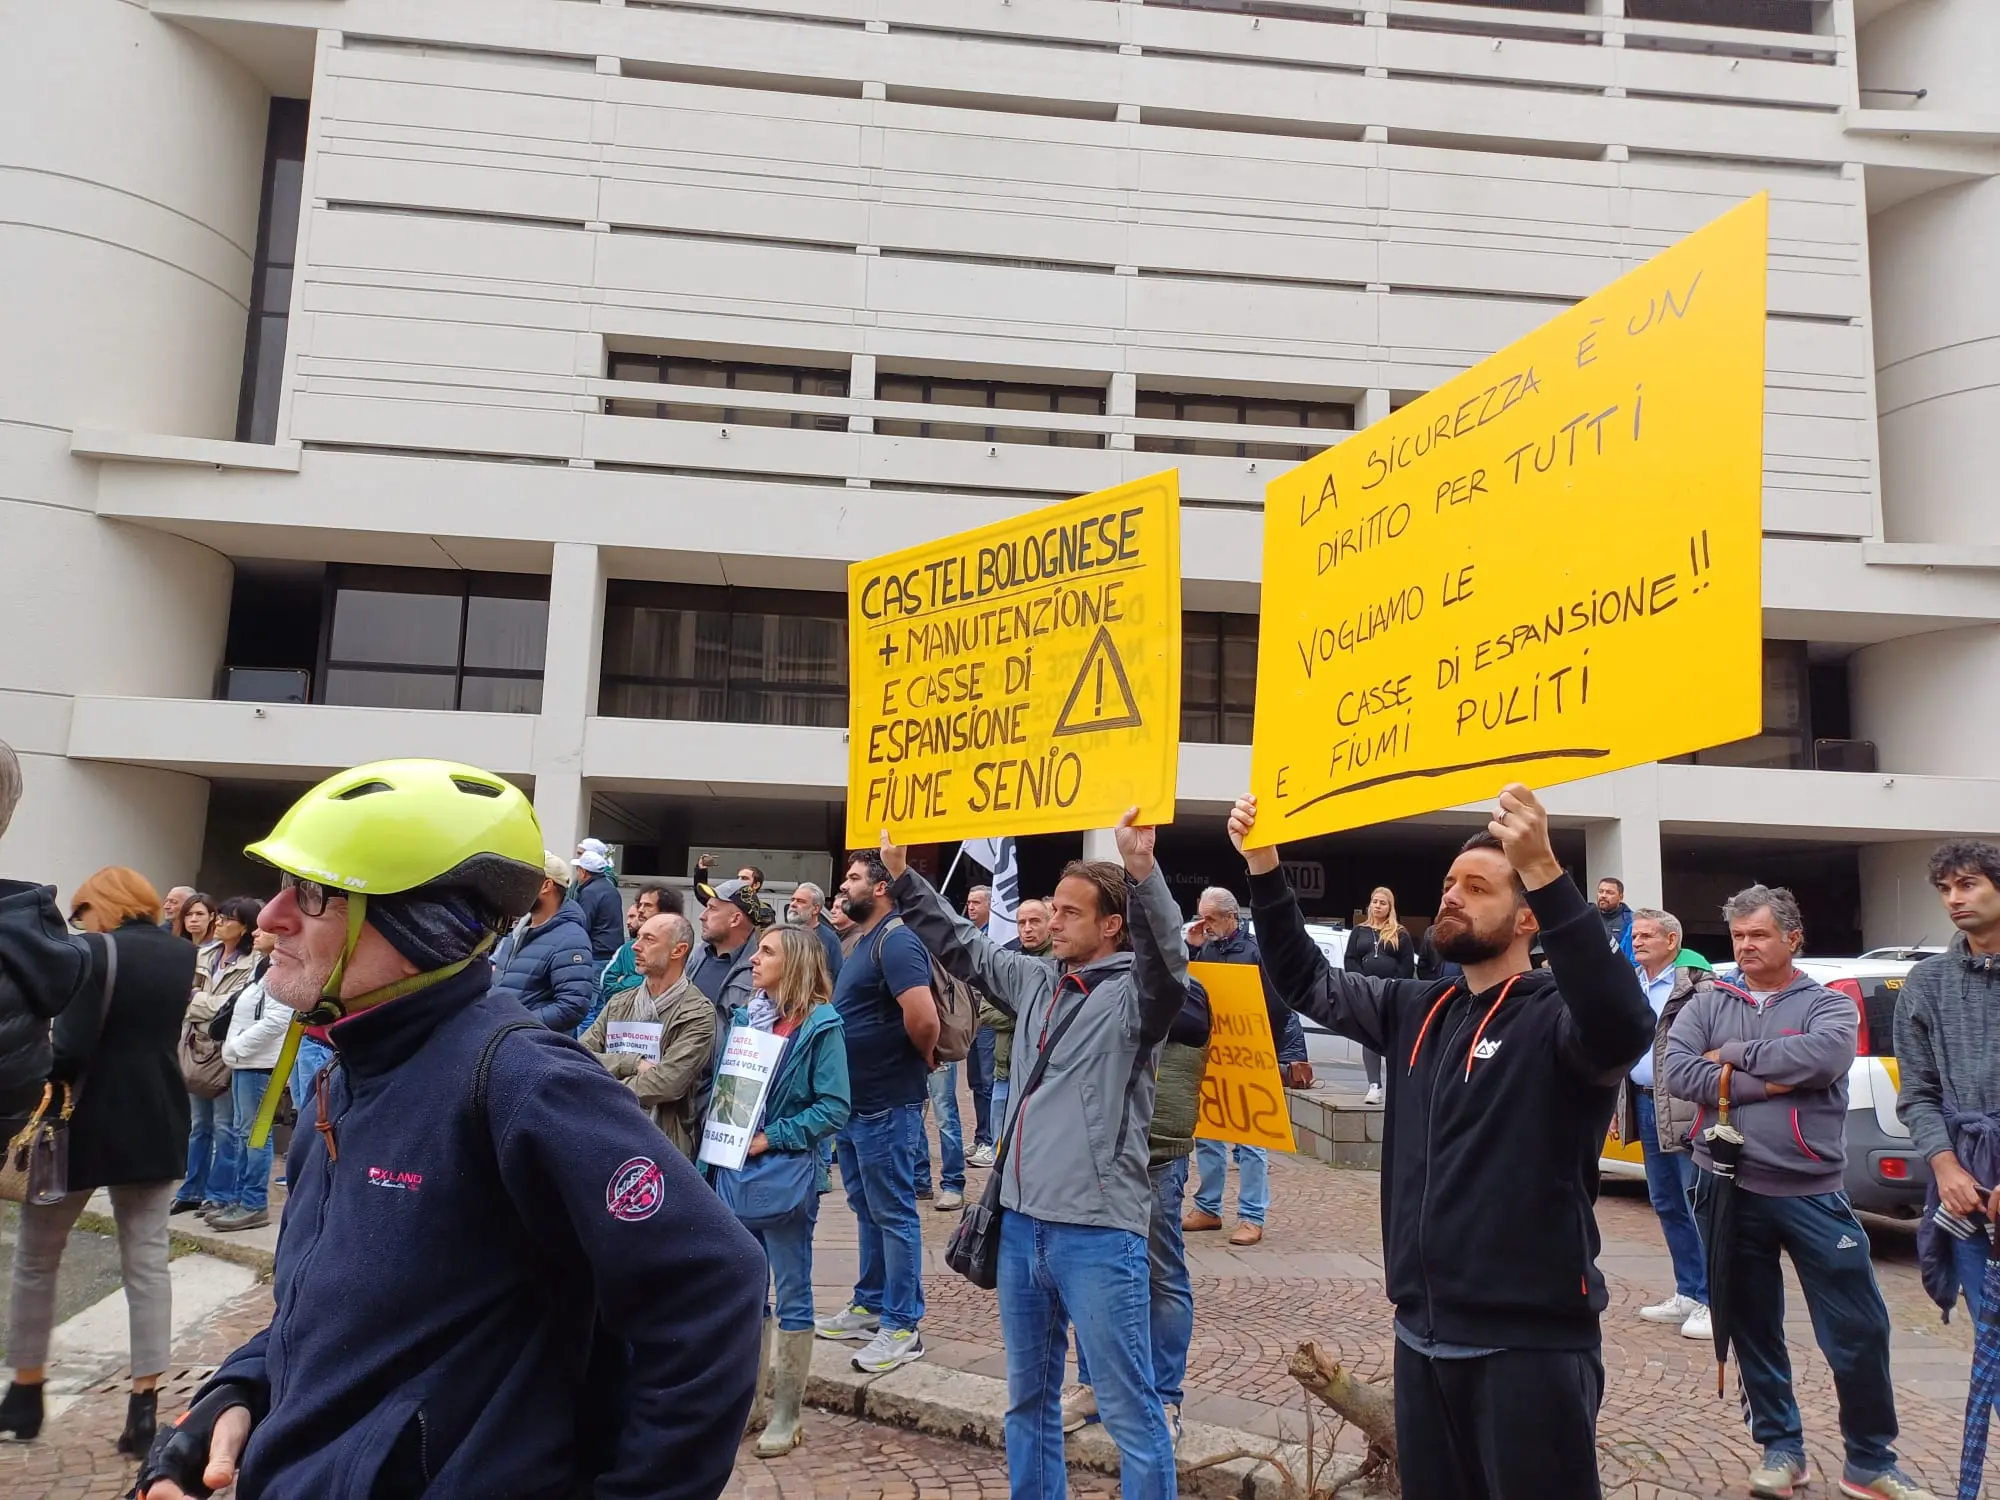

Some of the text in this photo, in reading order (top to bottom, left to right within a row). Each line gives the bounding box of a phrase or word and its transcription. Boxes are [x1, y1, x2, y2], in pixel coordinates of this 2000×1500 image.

[1300, 473, 1338, 526] LA
[1627, 270, 1704, 337] UN
[1435, 468, 1489, 515] PER
[1443, 565, 1475, 609] LE
[879, 634, 899, 667] +
[882, 678, 901, 716] E
[907, 661, 986, 708] CASSE
[1337, 675, 1413, 727] CASSE
[1883, 978, 1906, 991] IST
[622, 1031, 660, 1042] BOLOGNES
[742, 1060, 769, 1075] VOLTE
